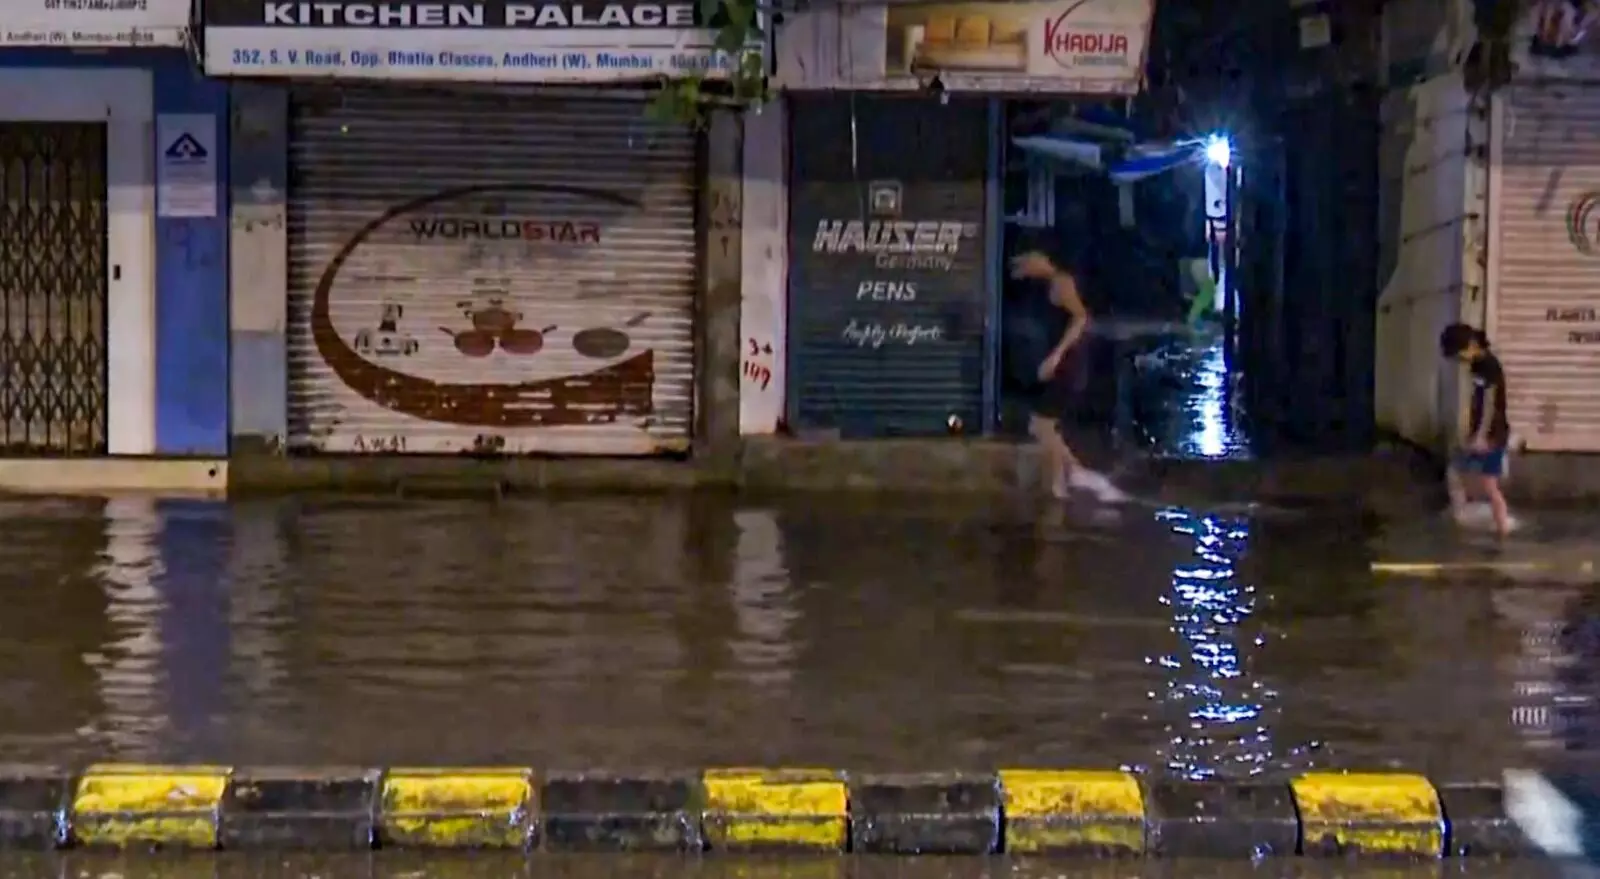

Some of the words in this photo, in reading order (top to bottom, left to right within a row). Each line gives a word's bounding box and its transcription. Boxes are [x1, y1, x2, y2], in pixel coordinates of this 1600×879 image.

[264, 3, 484, 26] KITCHEN
[505, 4, 694, 26] PALACE
[1044, 18, 1128, 55] KHADIJA
[232, 49, 264, 66] 352,
[270, 50, 282, 65] S.
[305, 50, 346, 67] Road,
[351, 51, 382, 68] Opp.
[388, 51, 434, 66] Bhatia
[439, 52, 497, 68] Classes,
[503, 52, 557, 68] Andheri
[596, 52, 653, 68] Mumbai
[857, 281, 917, 301] PENS
